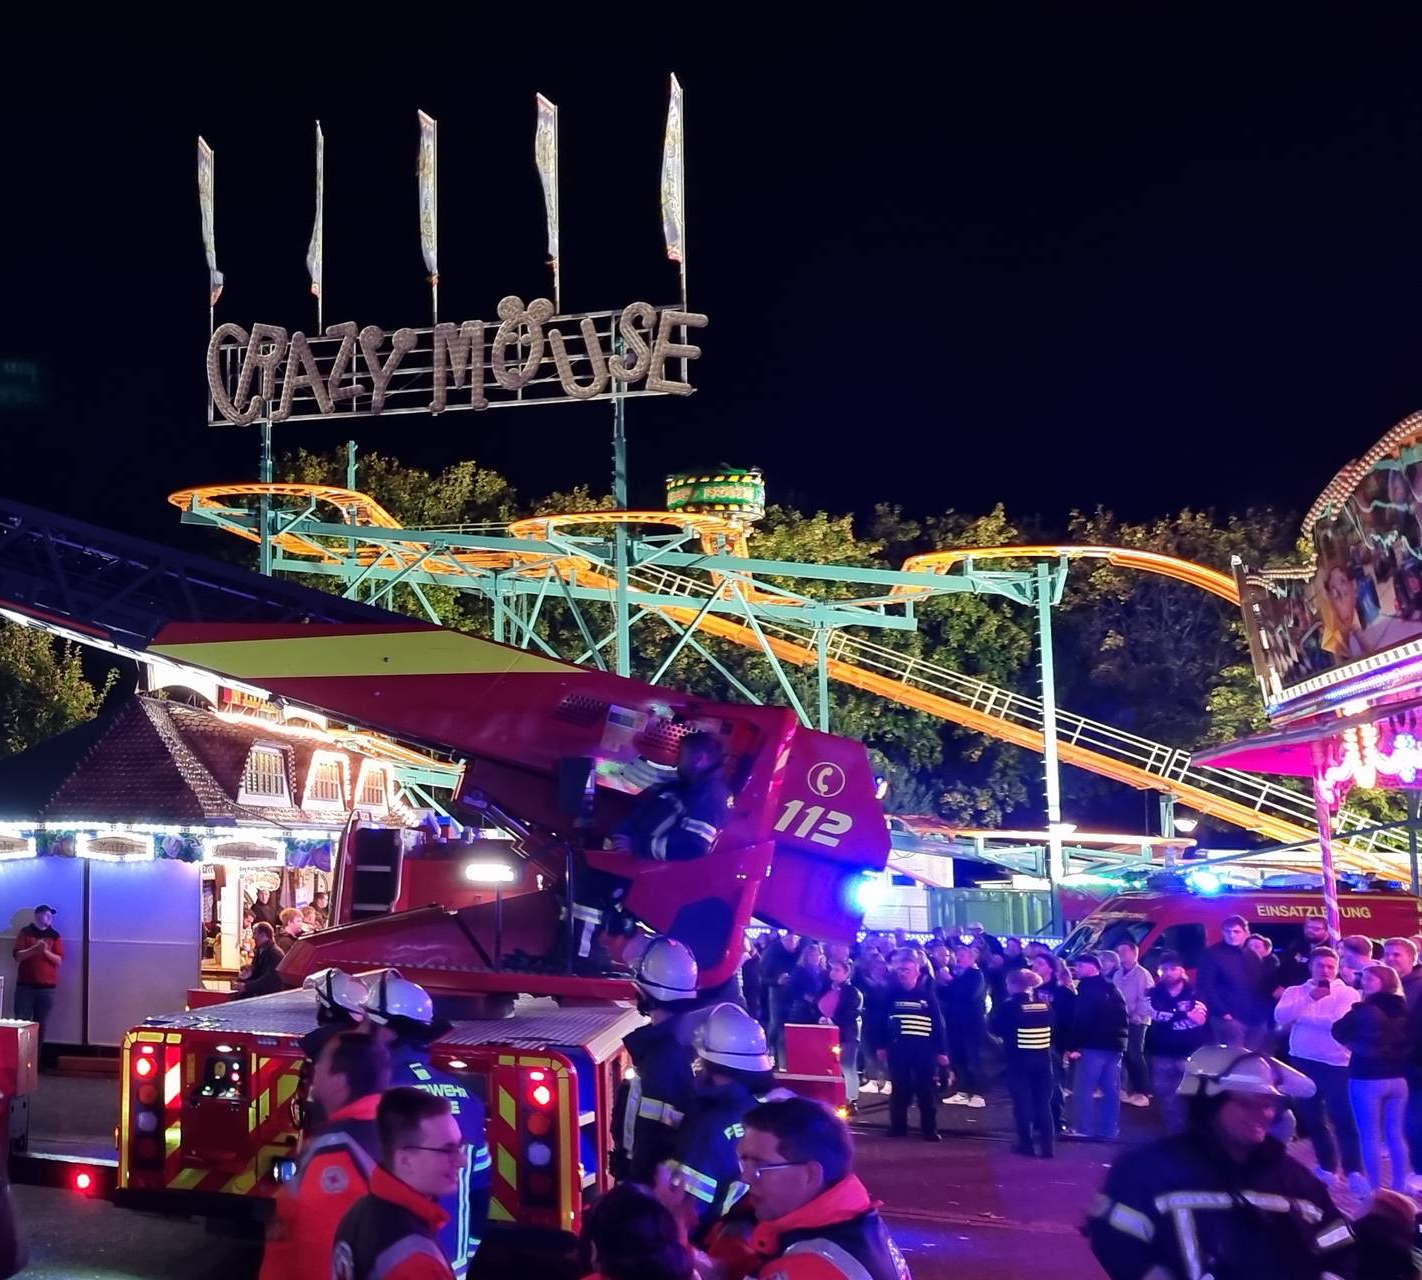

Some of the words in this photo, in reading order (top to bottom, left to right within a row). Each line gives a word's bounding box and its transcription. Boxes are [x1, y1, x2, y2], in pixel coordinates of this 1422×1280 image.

[207, 321, 418, 427] CRAZY
[428, 295, 709, 414] MOUSE
[774, 799, 853, 848] 112
[1256, 905, 1371, 918] EINSATZLEUNG
